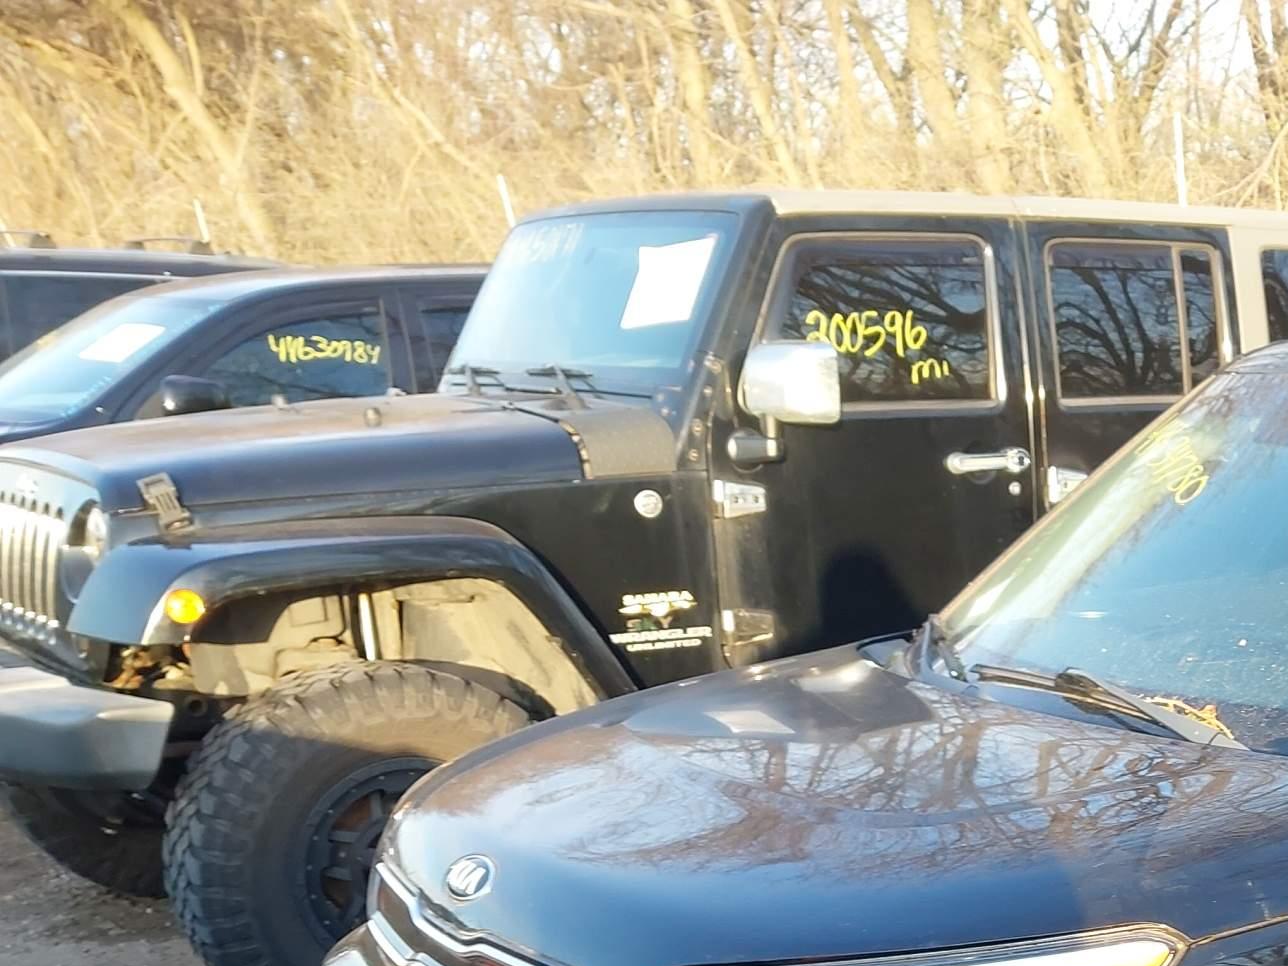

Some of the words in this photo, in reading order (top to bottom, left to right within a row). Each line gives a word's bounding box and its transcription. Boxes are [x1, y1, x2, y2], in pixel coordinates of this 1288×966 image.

[805, 309, 928, 358] 200596
[267, 334, 381, 365] 44630984
[608, 626, 713, 645] WRANGLER
[625, 638, 703, 652] UNLIMITED
